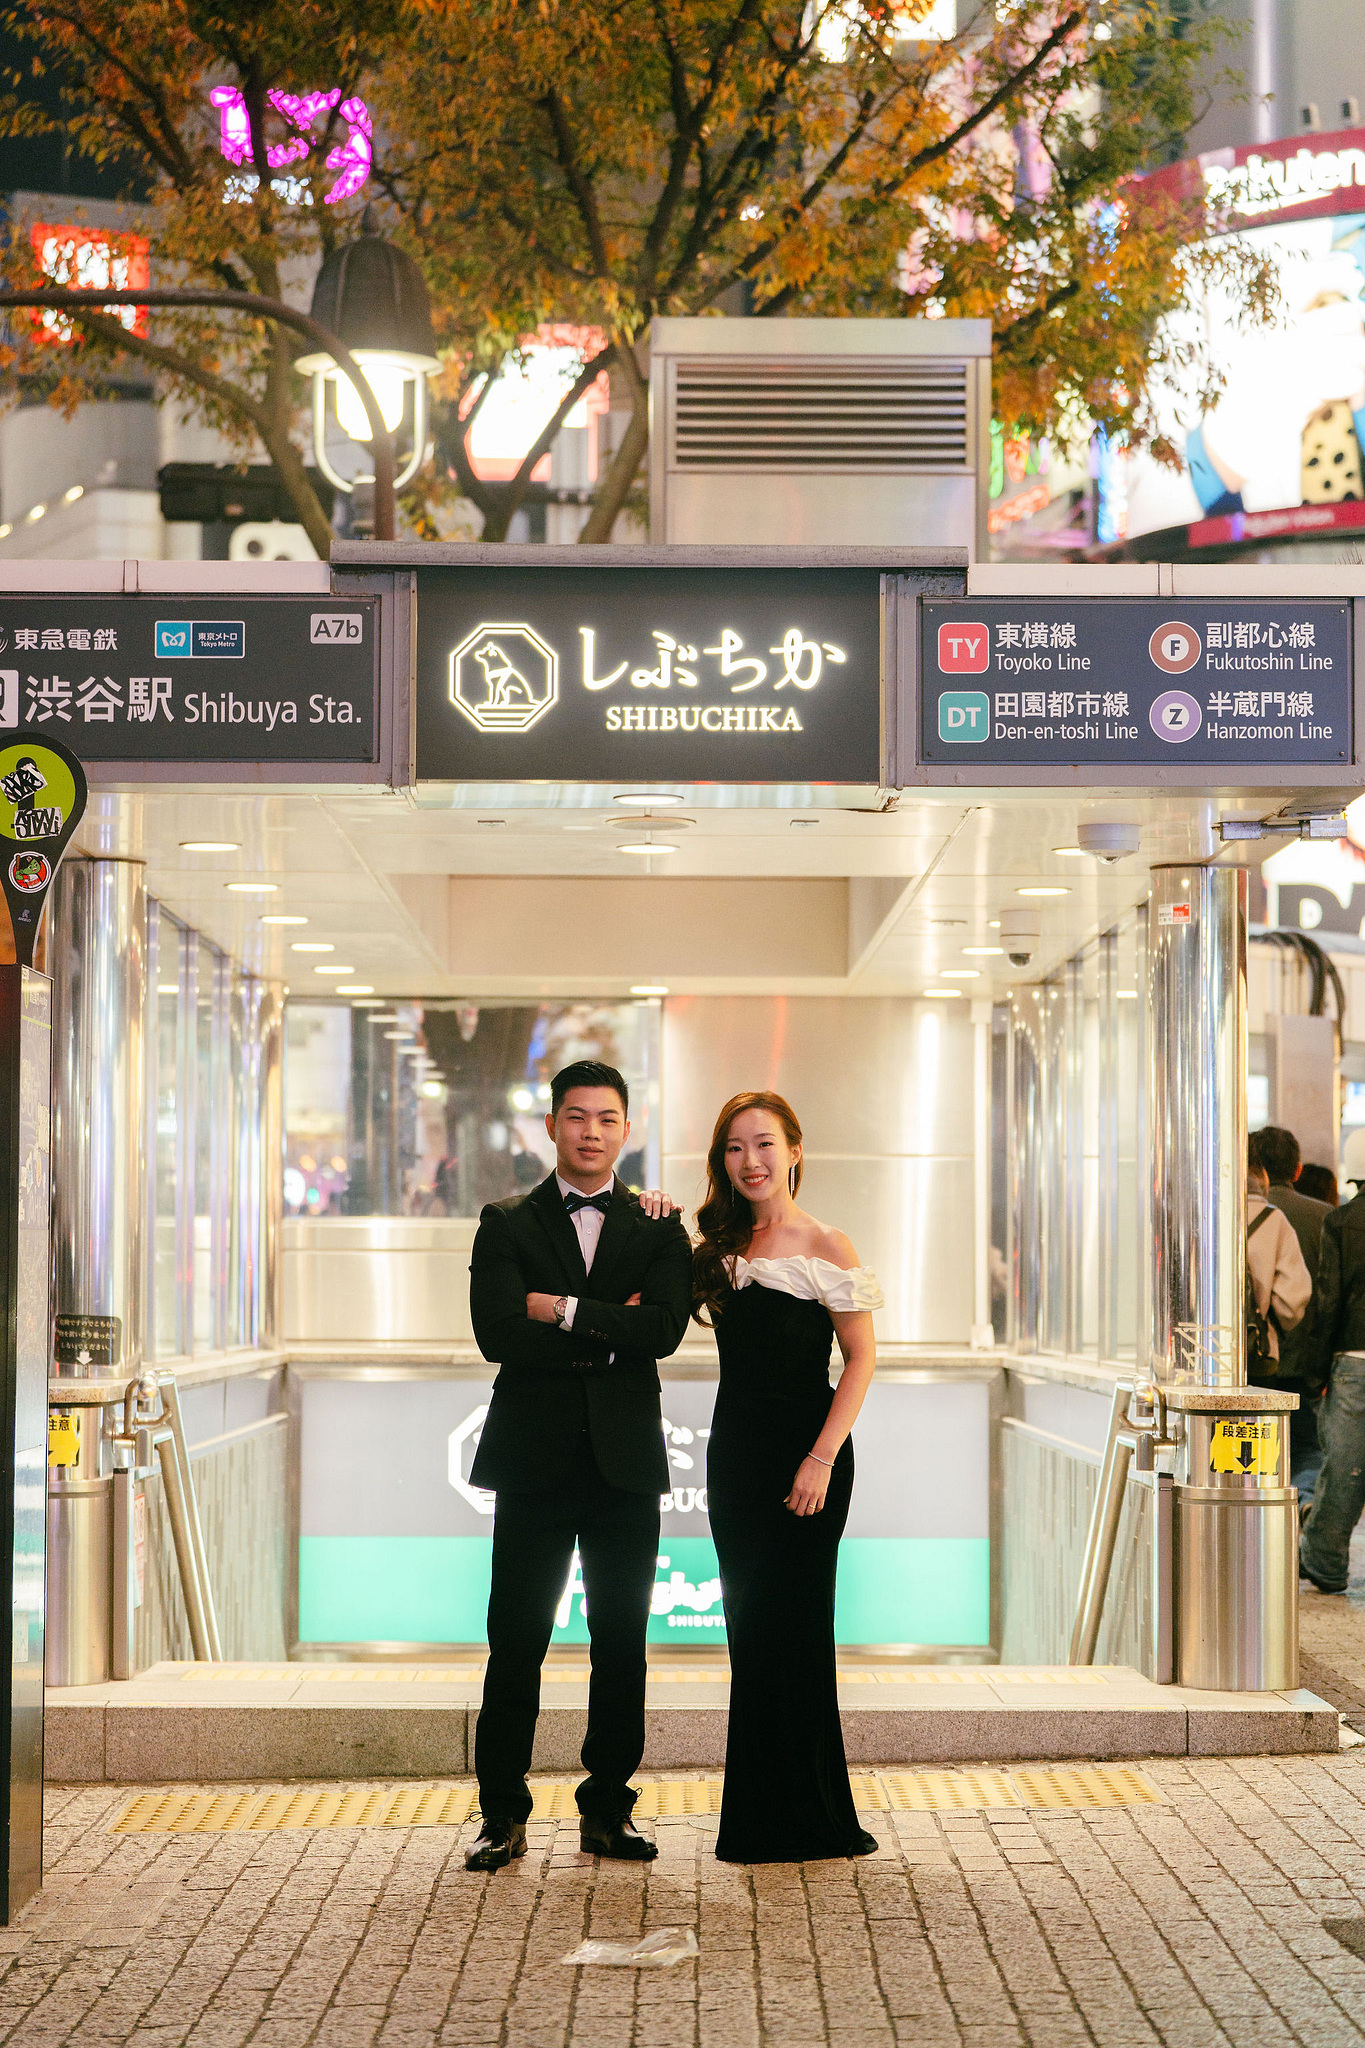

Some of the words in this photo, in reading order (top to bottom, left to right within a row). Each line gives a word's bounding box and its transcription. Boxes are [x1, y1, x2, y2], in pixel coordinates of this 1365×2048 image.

[14, 628, 118, 651] 東急電鉄
[198, 632, 238, 641] 東京メトロ
[313, 619, 360, 638] A7b
[995, 622, 1078, 649] 東横線
[1206, 621, 1316, 649] 副都心線
[579, 626, 848, 693] しぶちか
[947, 638, 981, 659] TY
[1171, 640, 1181, 657] F
[995, 653, 1052, 675] Toyoko
[1058, 652, 1091, 671] Line
[1206, 652, 1294, 671] Fukutoshin
[1301, 652, 1333, 671] Line
[25, 675, 175, 723] 渋谷駅
[995, 692, 1130, 718] 田園都市線
[1207, 691, 1314, 718] 半蔵門線
[184, 692, 298, 732] Shibuya
[309, 694, 362, 723] Sta.
[605, 706, 803, 732] SHIBUCHIKA
[948, 707, 981, 728] DT
[1168, 709, 1183, 726] Z
[995, 721, 1099, 741] Den-en-toshi
[1106, 721, 1139, 740] Line
[1207, 722, 1293, 740] Hanzomon
[1300, 721, 1333, 740] Line
[1222, 1425, 1272, 1440] 段差注意
